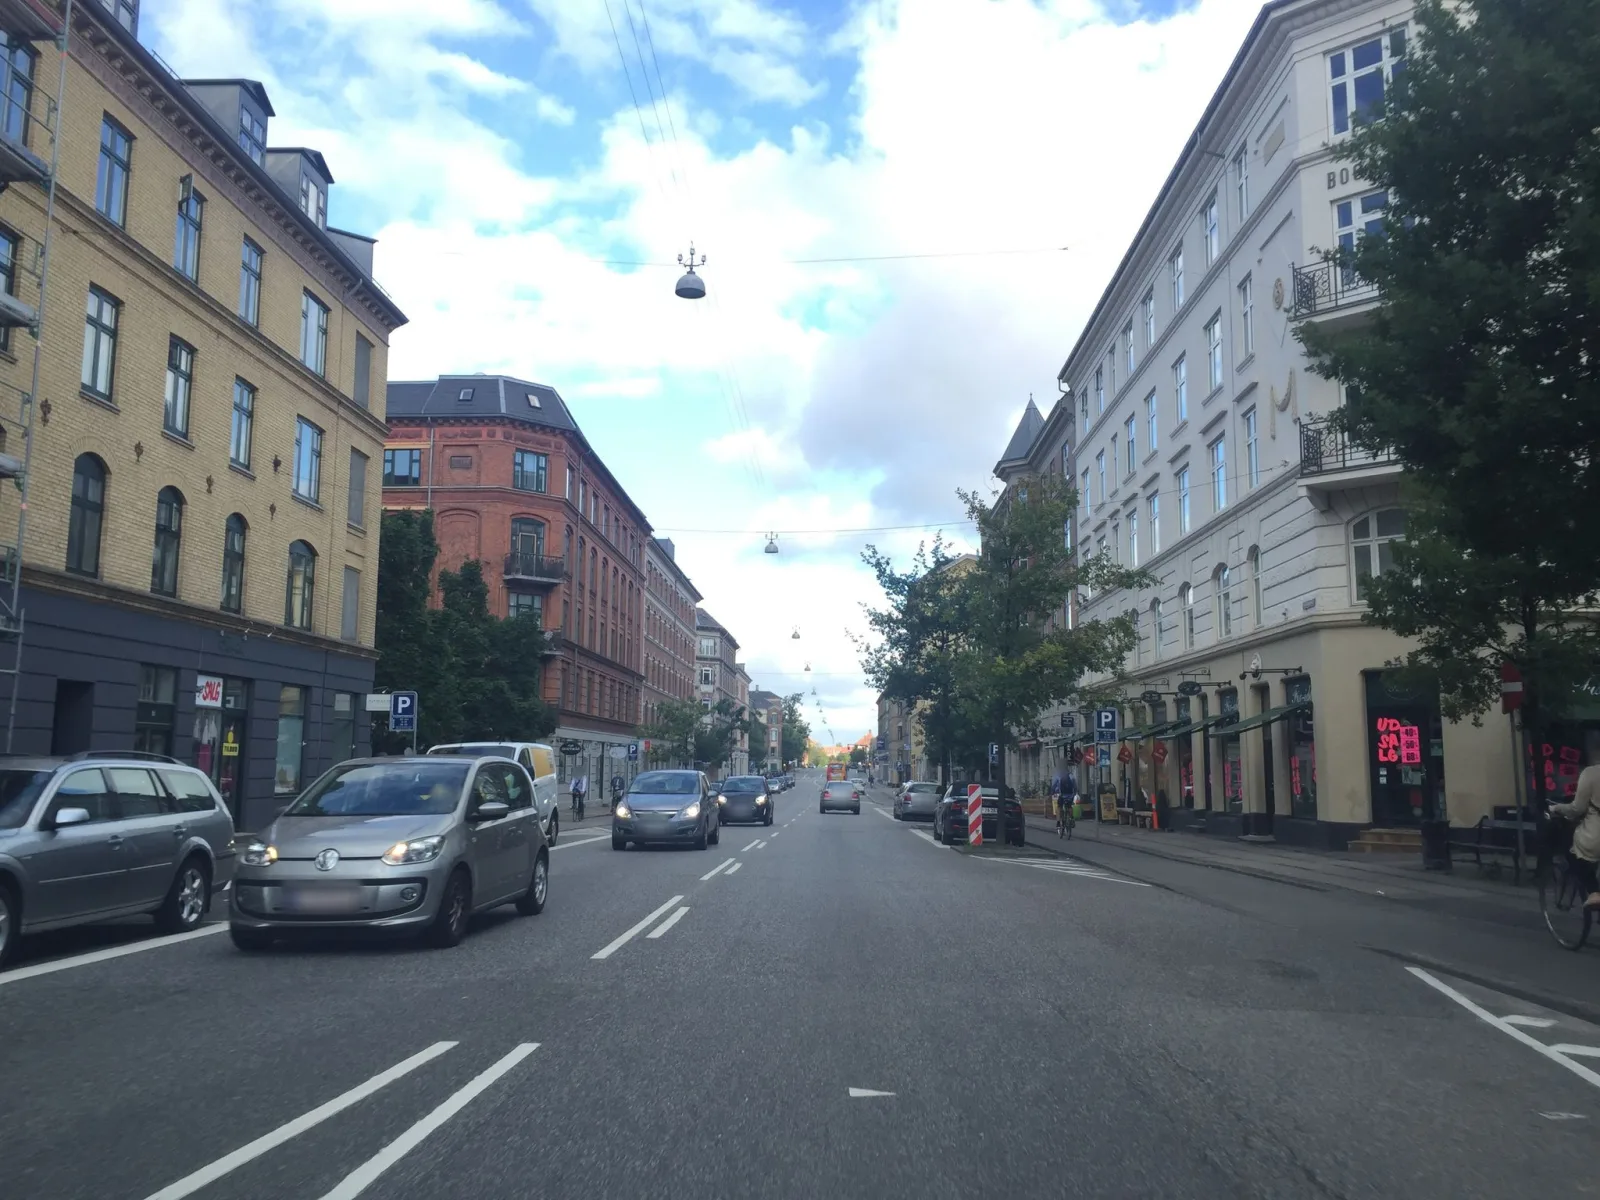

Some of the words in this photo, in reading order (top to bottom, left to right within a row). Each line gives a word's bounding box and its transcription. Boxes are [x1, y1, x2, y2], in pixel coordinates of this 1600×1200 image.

[398, 696, 411, 714] P
[1101, 711, 1113, 728] P
[1377, 717, 1400, 732] UD
[1378, 733, 1399, 749] SA
[629, 745, 637, 754] P
[1379, 748, 1399, 762] LG
